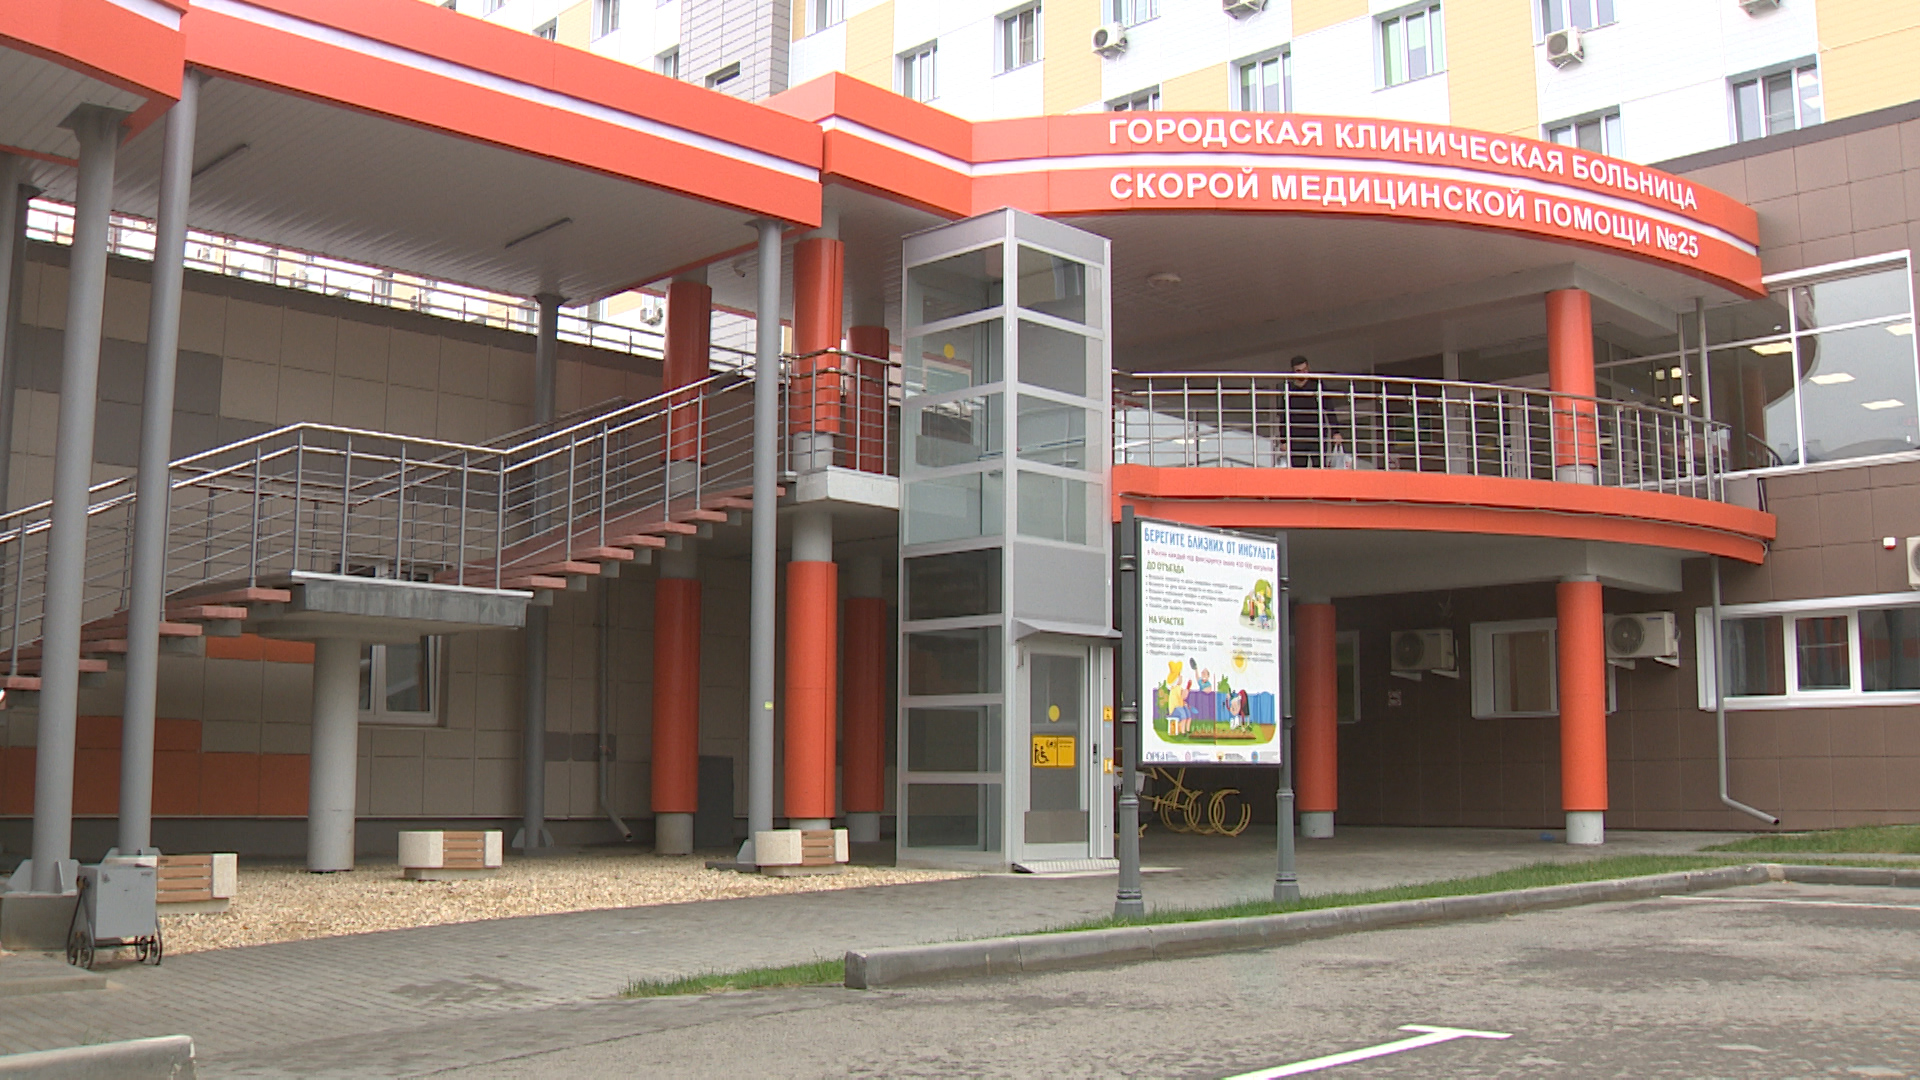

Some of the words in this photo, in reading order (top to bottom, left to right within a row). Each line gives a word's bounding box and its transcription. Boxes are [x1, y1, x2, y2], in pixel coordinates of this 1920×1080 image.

[1109, 118, 1323, 148] ГОРОДСКАЯ
[1335, 122, 1564, 175] КЛИНИЧЕСКАЯ
[1572, 153, 1698, 211] БОЛЬНИЦА
[1110, 166, 1259, 200] СКОРОЙ
[1271, 174, 1525, 220] МЕДИЦИНСКОЙ
[1534, 197, 1650, 246] ПОМОЩИ
[1655, 225, 1699, 258] №25
[1144, 527, 1185, 548] БЕРЕГИТЕ
[1187, 535, 1224, 554] БЛИЗНИХ
[1226, 541, 1237, 554] ОТ
[1238, 543, 1276, 560] ИНСУЛЬТА
[1146, 561, 1156, 570] ДО
[1148, 615, 1157, 624] НА
